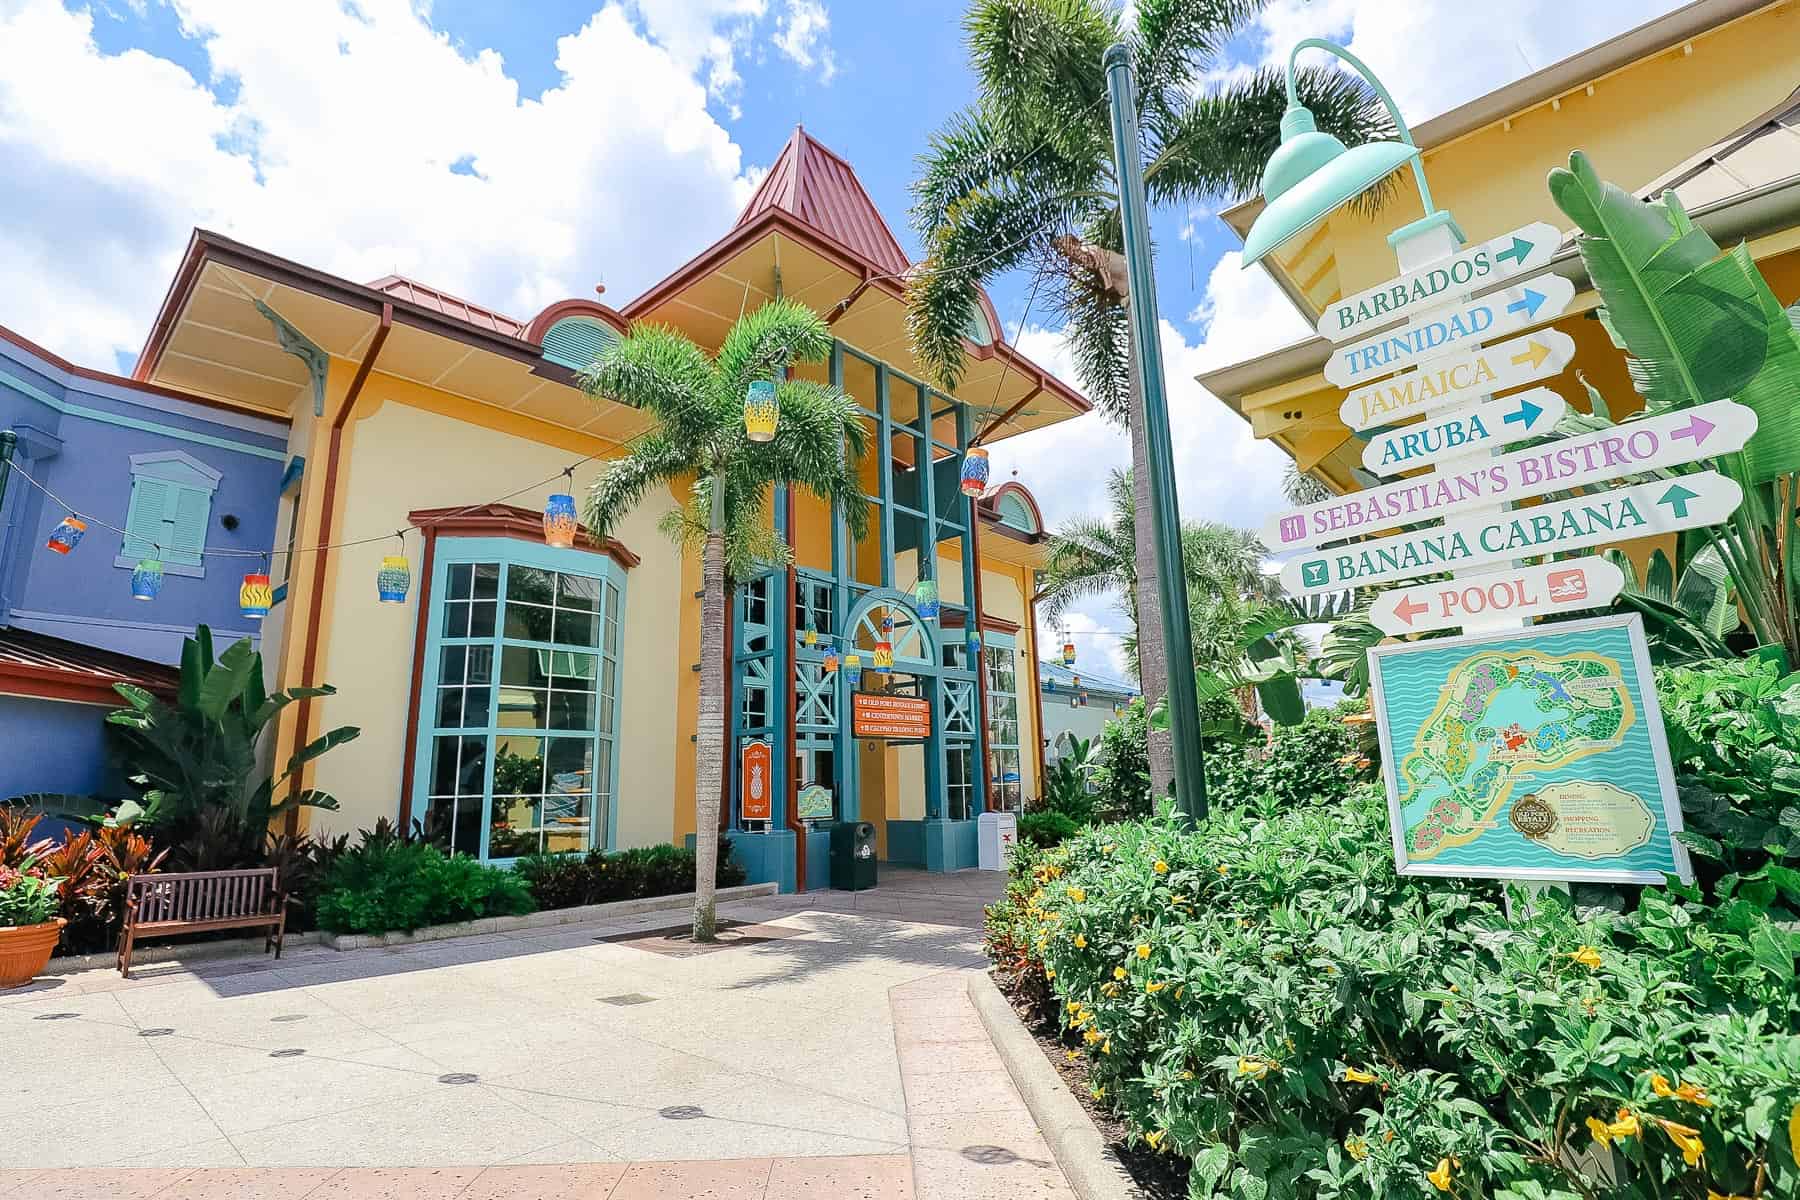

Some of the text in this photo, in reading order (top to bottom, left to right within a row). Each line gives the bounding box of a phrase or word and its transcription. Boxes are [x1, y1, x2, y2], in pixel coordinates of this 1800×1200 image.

[1337, 252, 1490, 330] BARBADOS
[1344, 306, 1493, 376] TRINIDAD
[1358, 357, 1497, 426] JAMAICA
[1381, 414, 1490, 466] ARUBA
[1313, 429, 1660, 535] SEBASTIAN’S BISTRO
[1335, 497, 1647, 581] BANANA CABANA
[1438, 578, 1538, 618] POOL
